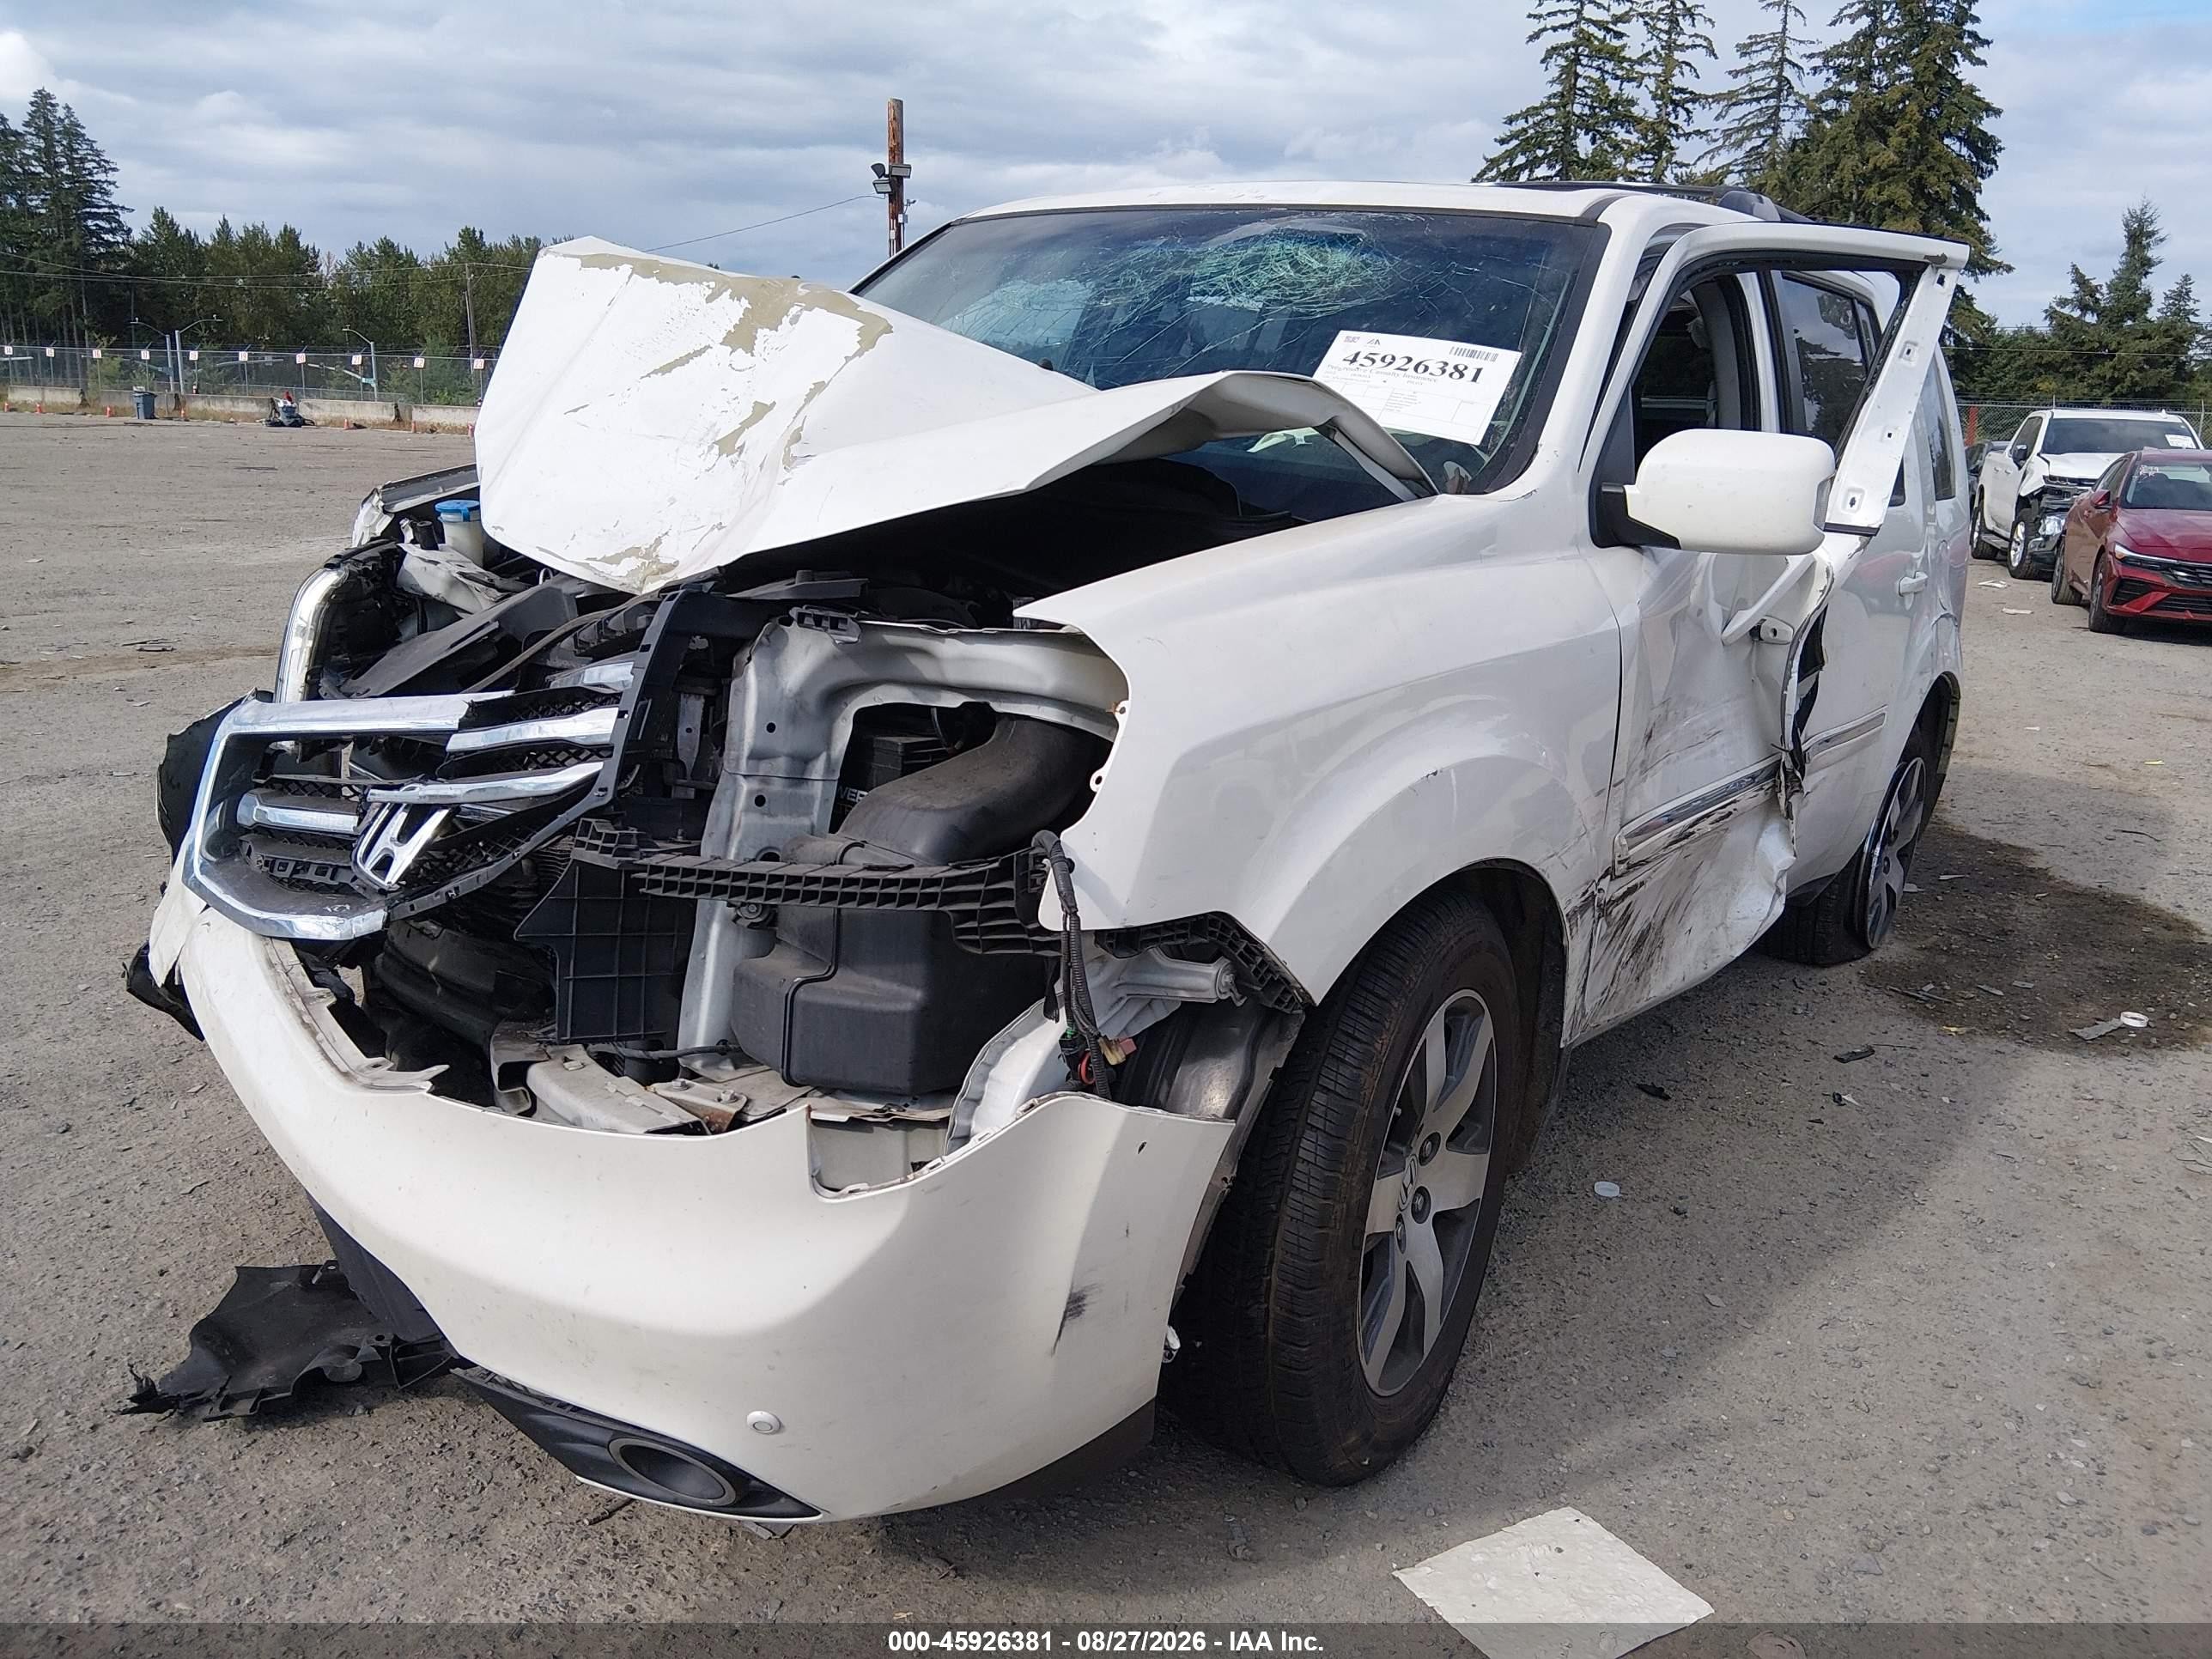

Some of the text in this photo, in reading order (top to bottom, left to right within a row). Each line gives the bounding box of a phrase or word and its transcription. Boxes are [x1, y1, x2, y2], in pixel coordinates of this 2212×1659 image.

[1342, 351, 1483, 384] 45926381
[1370, 368, 1400, 378] Casualty
[1402, 372, 1437, 383] Insurance
